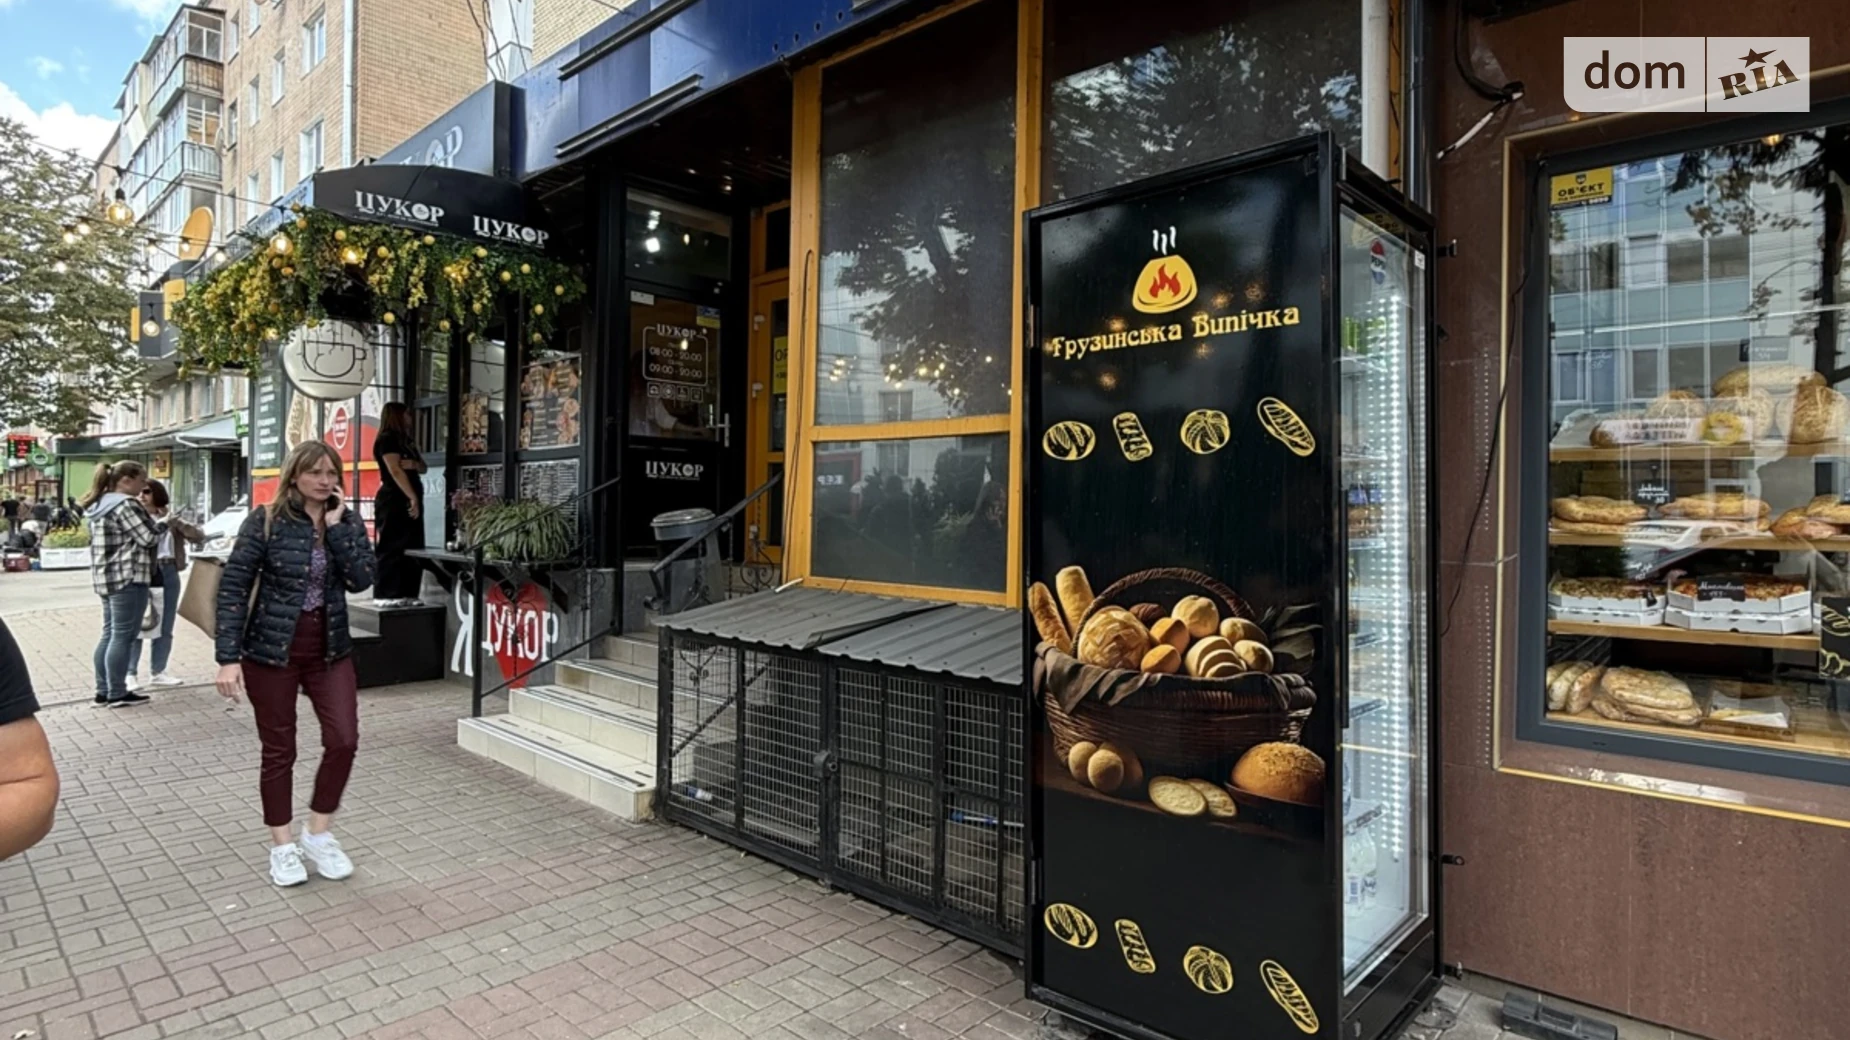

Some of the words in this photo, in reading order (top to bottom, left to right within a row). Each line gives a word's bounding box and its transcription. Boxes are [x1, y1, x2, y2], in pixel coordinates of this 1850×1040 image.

[1558, 182, 1604, 197] ОБ'ЄКТ
[355, 190, 445, 222] ЦУКОР
[473, 214, 549, 245] ЦУКОР
[656, 323, 697, 340] ЦУКОР
[1192, 306, 1300, 338] Випічка
[645, 460, 704, 478] ЦУКОР
[451, 576, 474, 677] Я
